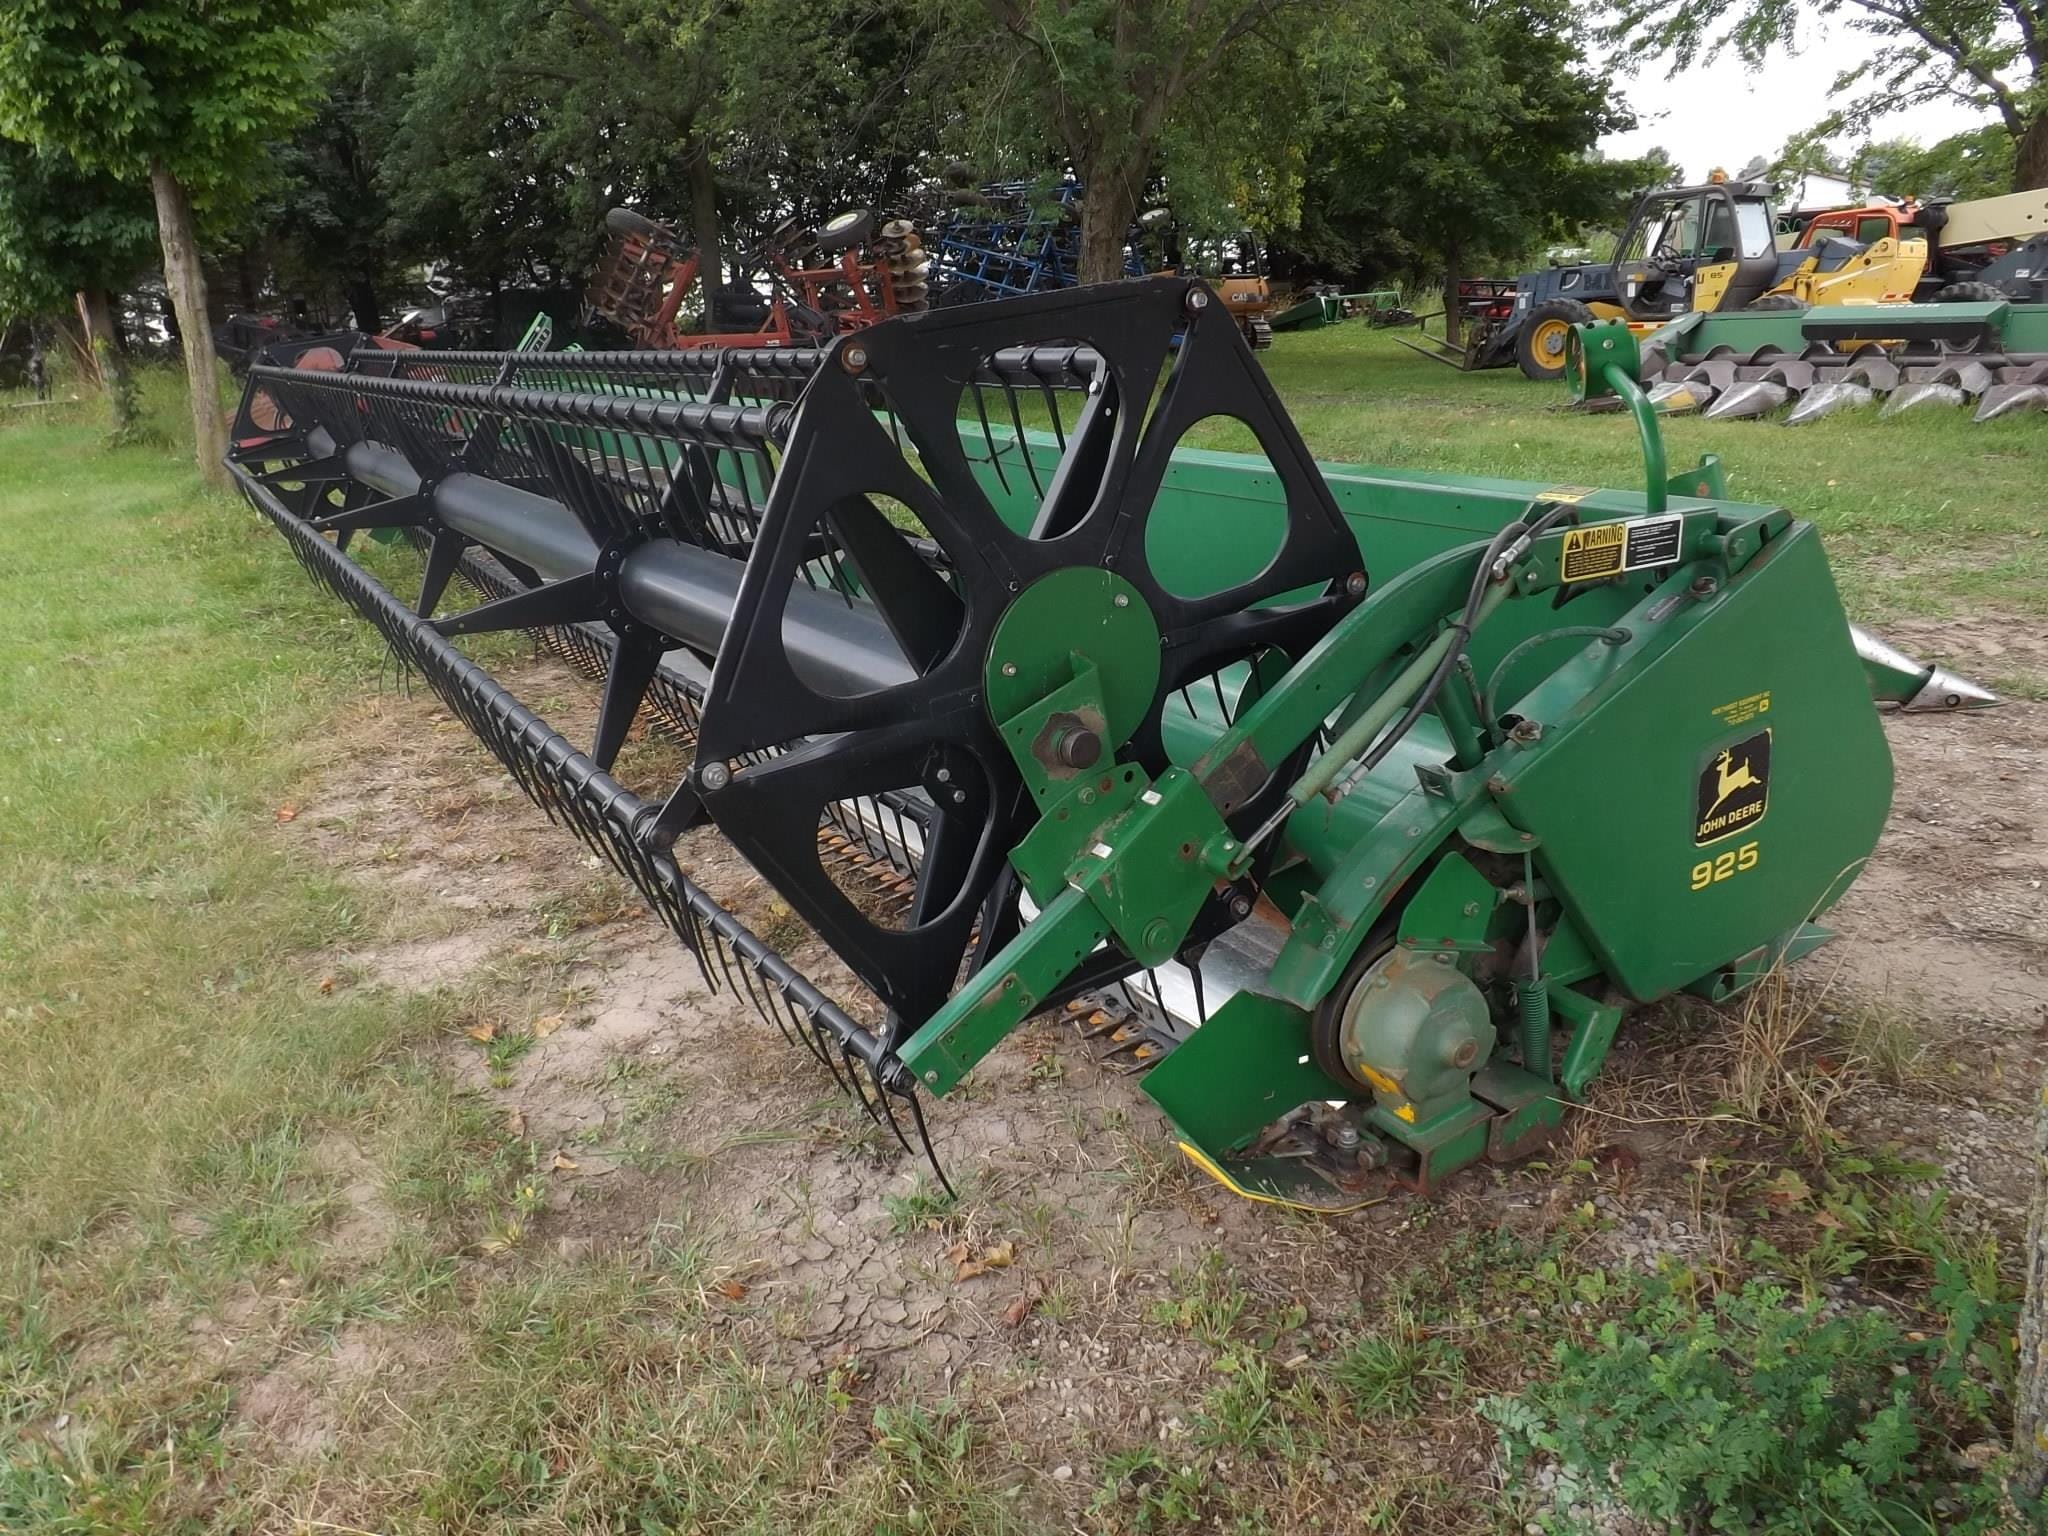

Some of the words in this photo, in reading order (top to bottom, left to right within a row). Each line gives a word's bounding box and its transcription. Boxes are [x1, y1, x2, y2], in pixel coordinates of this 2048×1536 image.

[1583, 526, 1623, 548] WARNING
[1697, 815, 1727, 837] JOHN
[1728, 800, 1763, 824] DEERE
[1690, 841, 1759, 891] 925
